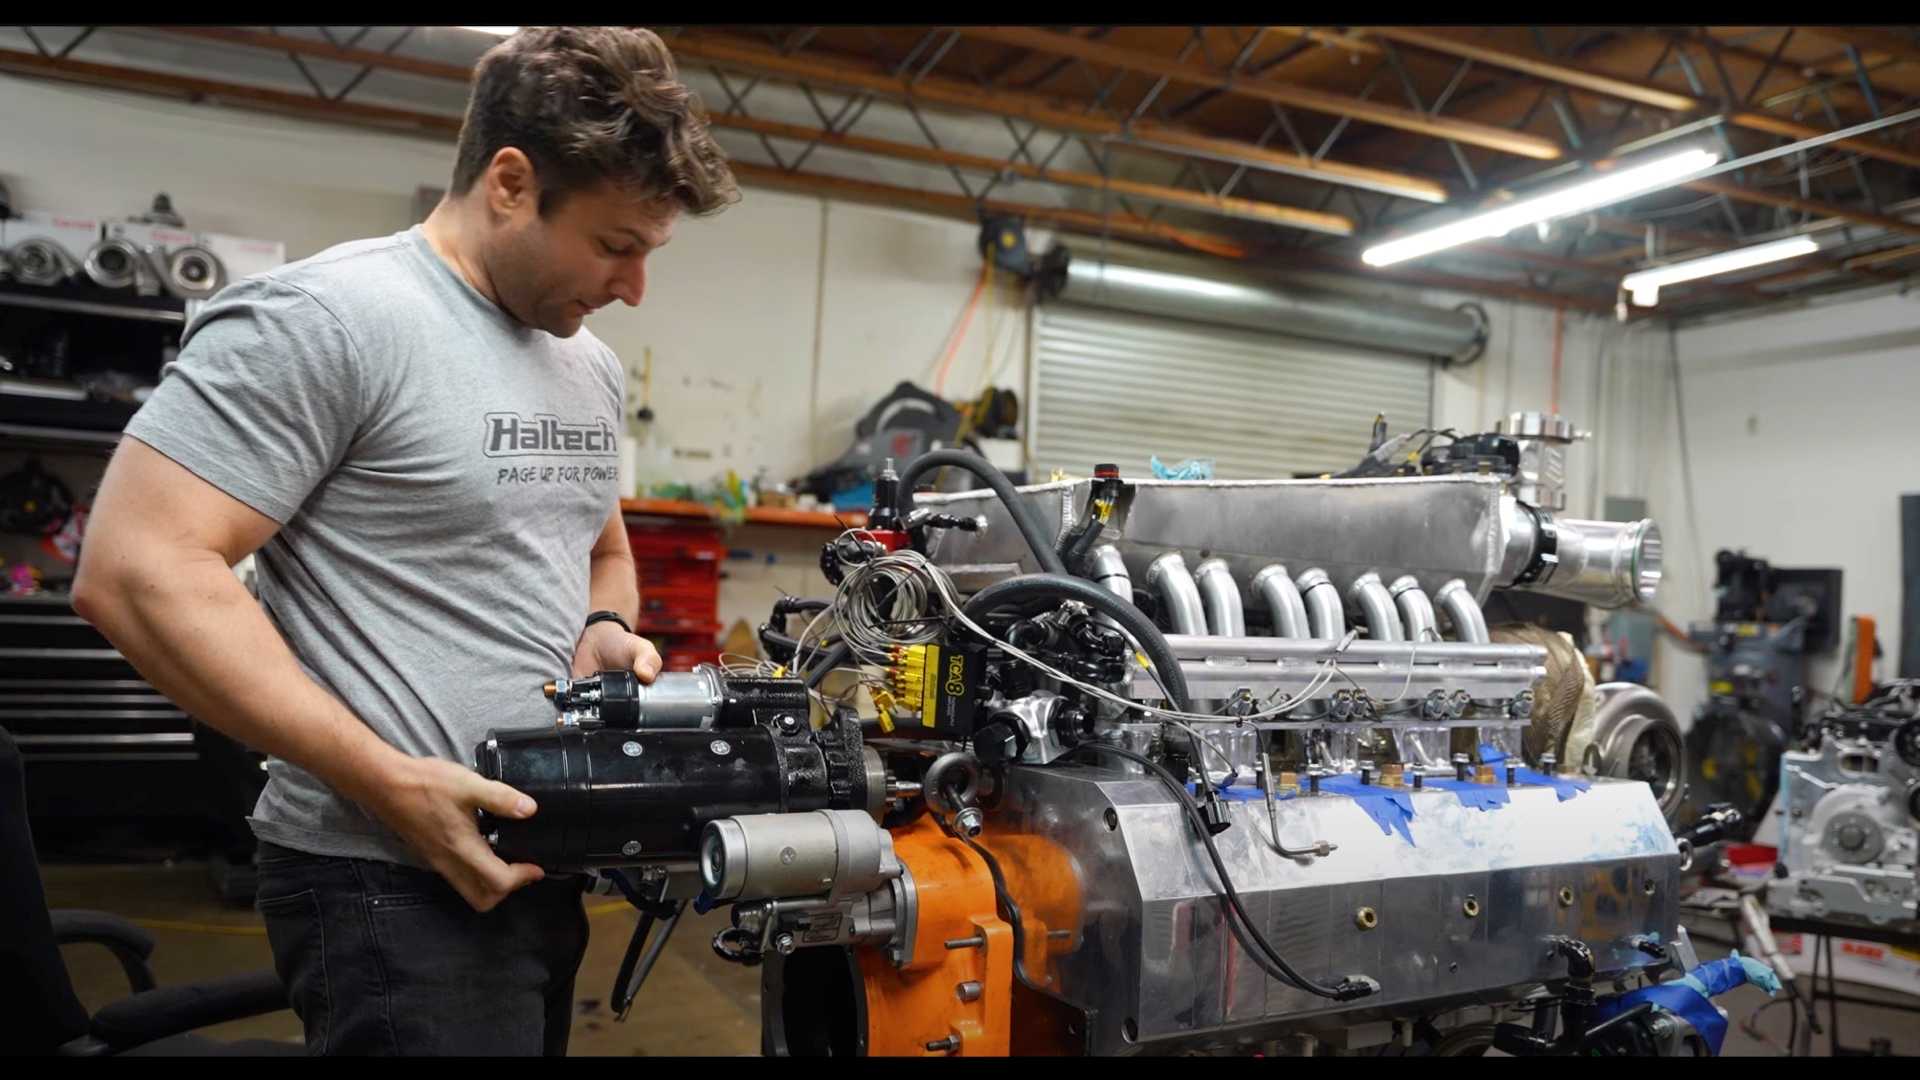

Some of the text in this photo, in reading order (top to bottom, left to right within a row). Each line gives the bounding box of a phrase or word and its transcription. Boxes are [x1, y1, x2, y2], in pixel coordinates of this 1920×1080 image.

[490, 418, 617, 451] Haltech
[497, 466, 537, 485] PAGE
[540, 466, 555, 482] UP
[557, 466, 581, 483] FOR
[945, 655, 965, 696] TCA8
